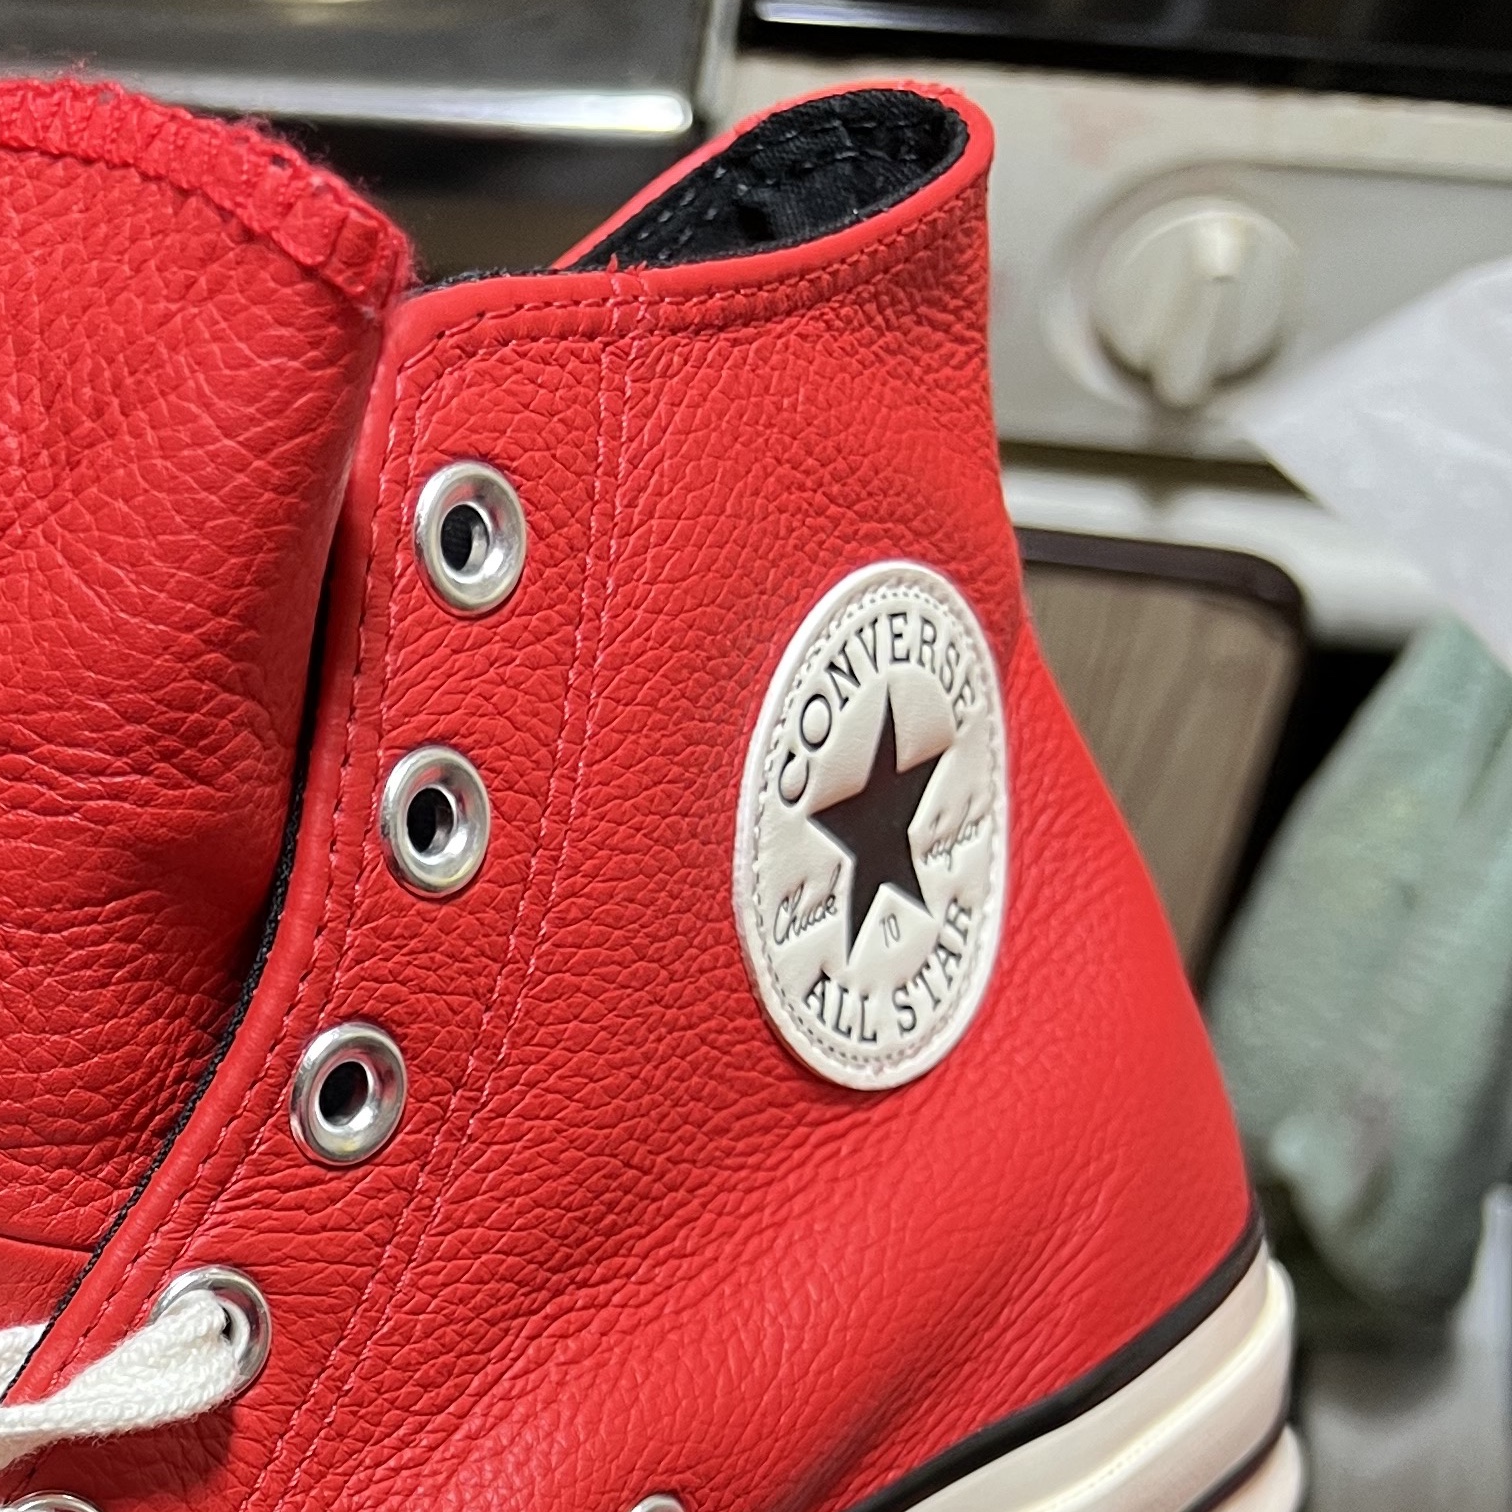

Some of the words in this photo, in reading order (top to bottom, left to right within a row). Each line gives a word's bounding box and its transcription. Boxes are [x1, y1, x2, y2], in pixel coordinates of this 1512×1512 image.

[778, 612, 977, 805] CONVERSE
[773, 862, 841, 945] Chuck
[803, 970, 878, 1042] ALL
[893, 898, 973, 1034] STAR
